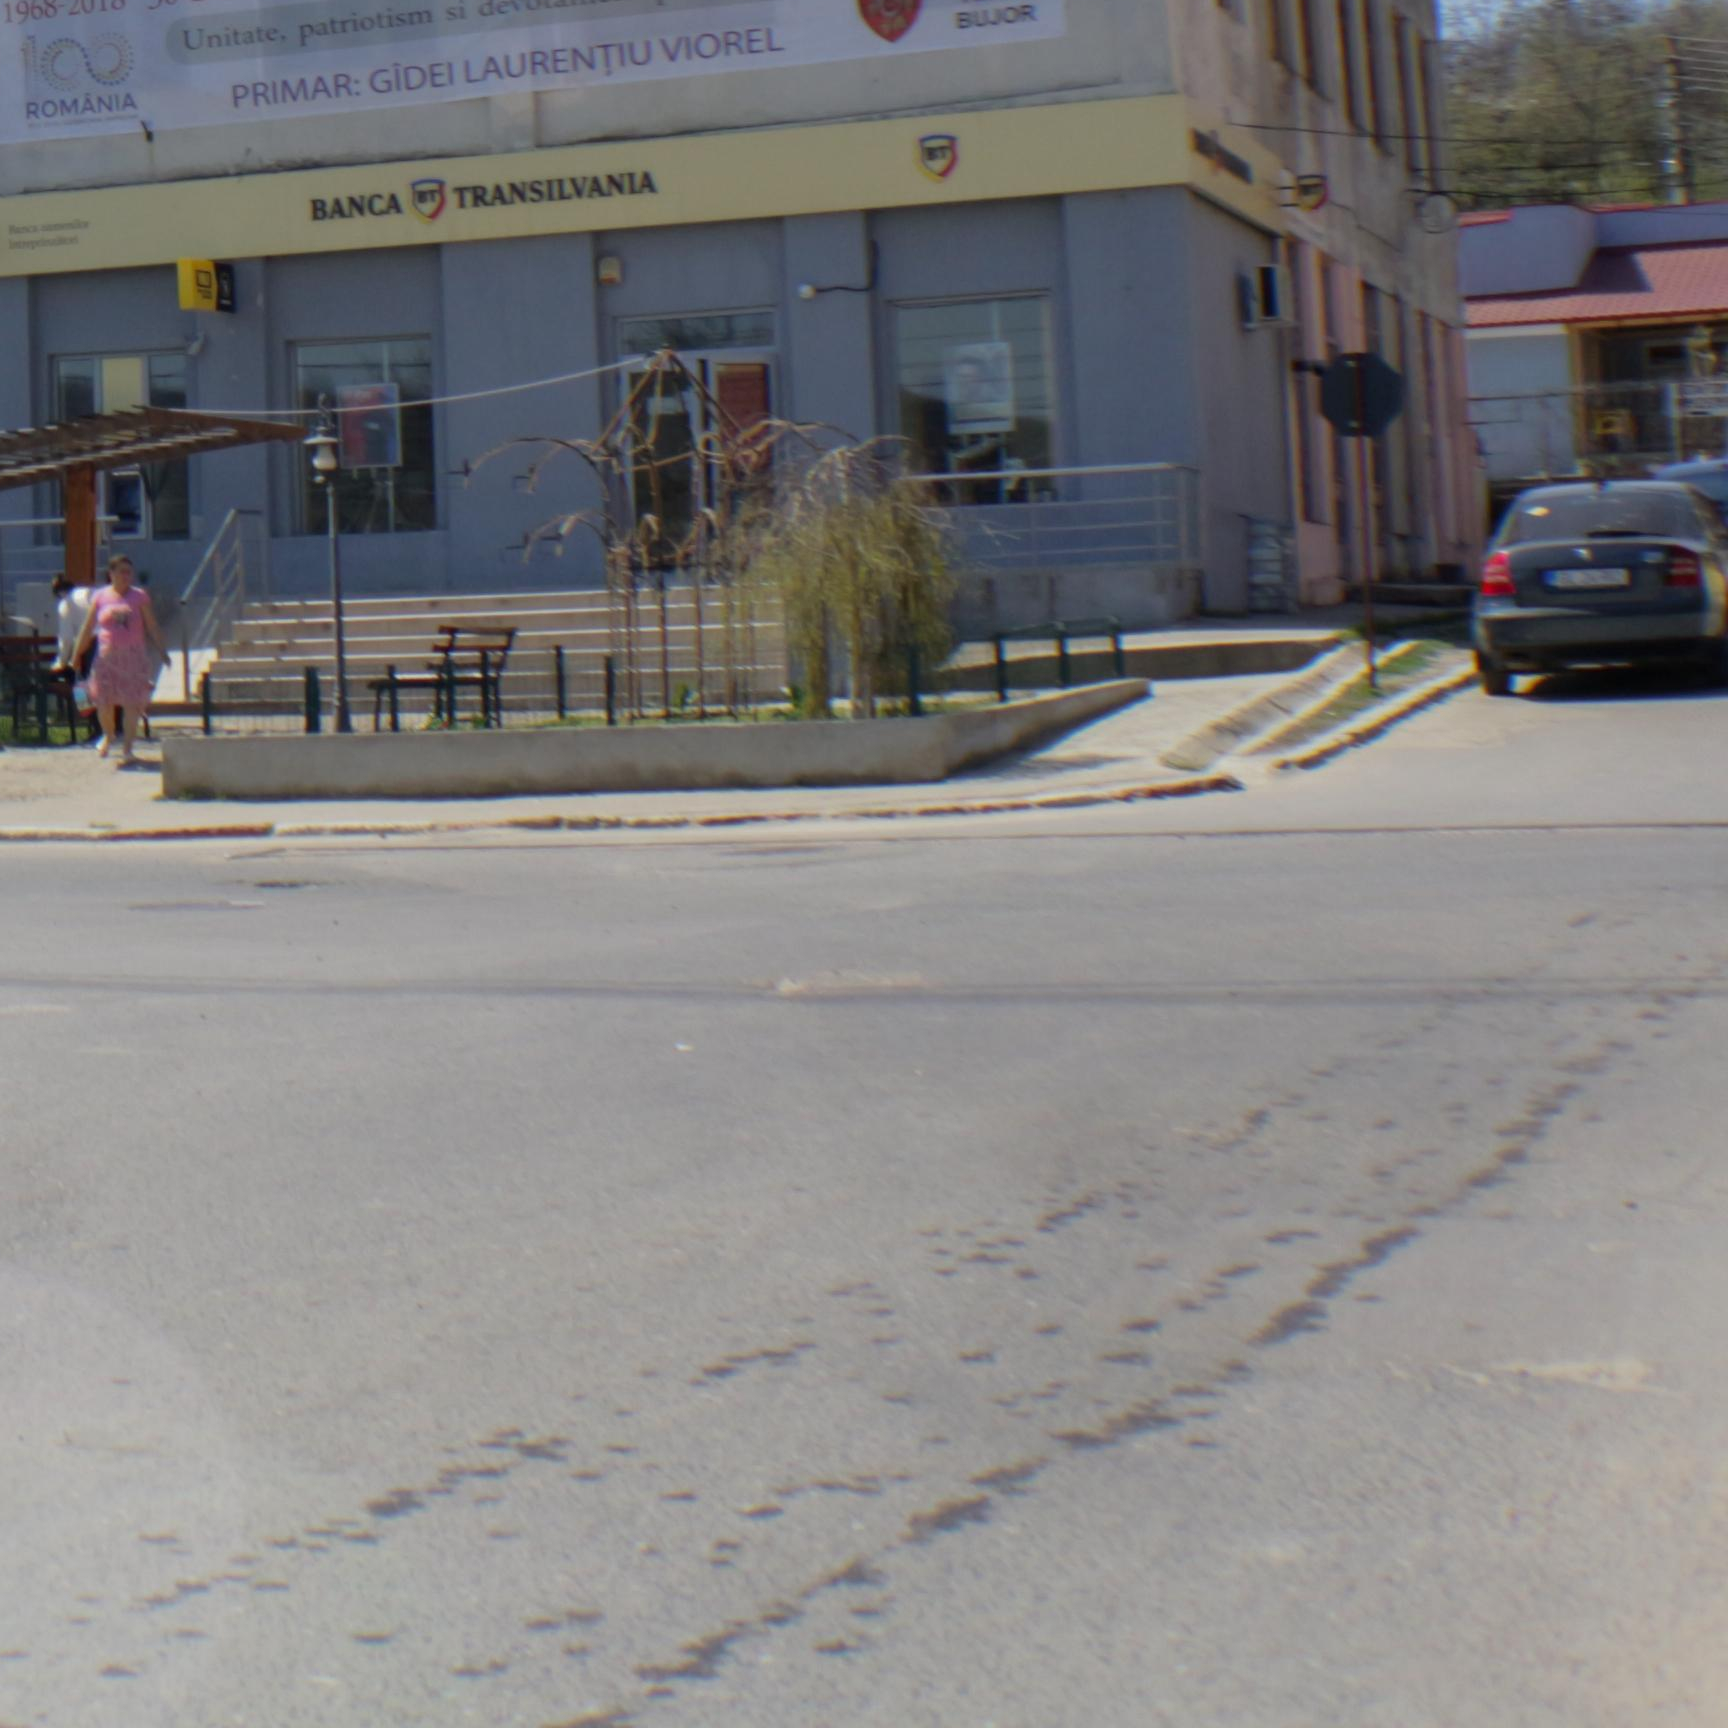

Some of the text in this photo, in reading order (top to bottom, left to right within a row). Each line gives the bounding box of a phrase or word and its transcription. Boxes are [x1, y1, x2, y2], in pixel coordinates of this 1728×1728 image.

[182, 25, 288, 52] Unitate,
[298, 7, 434, 48] patriotism
[446, 0, 468, 22] si
[955, 4, 1039, 29] BUJOR
[232, 71, 361, 109] PRIMAR:
[370, 60, 455, 95] GÎDEI
[659, 26, 785, 64] VIOREL
[25, 92, 139, 120] ROMÂNIA
[310, 192, 403, 221] BANCA
[452, 170, 659, 209] TRANSILVANIA
